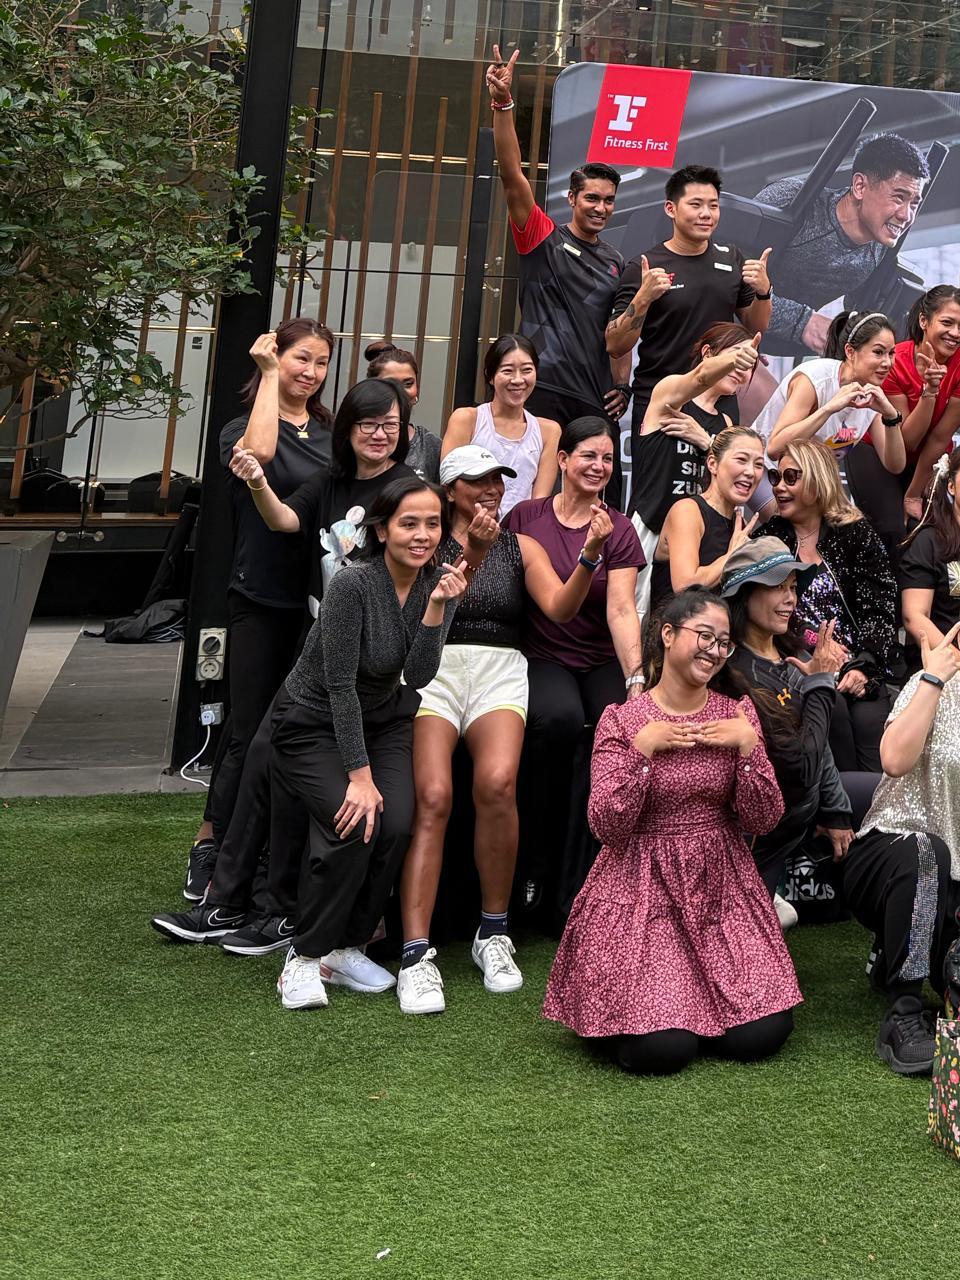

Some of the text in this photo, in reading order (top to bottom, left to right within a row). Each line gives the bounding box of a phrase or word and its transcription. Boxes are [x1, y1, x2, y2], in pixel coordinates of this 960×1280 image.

[604, 135, 669, 152] Fitness First
[784, 877, 835, 901] didas
